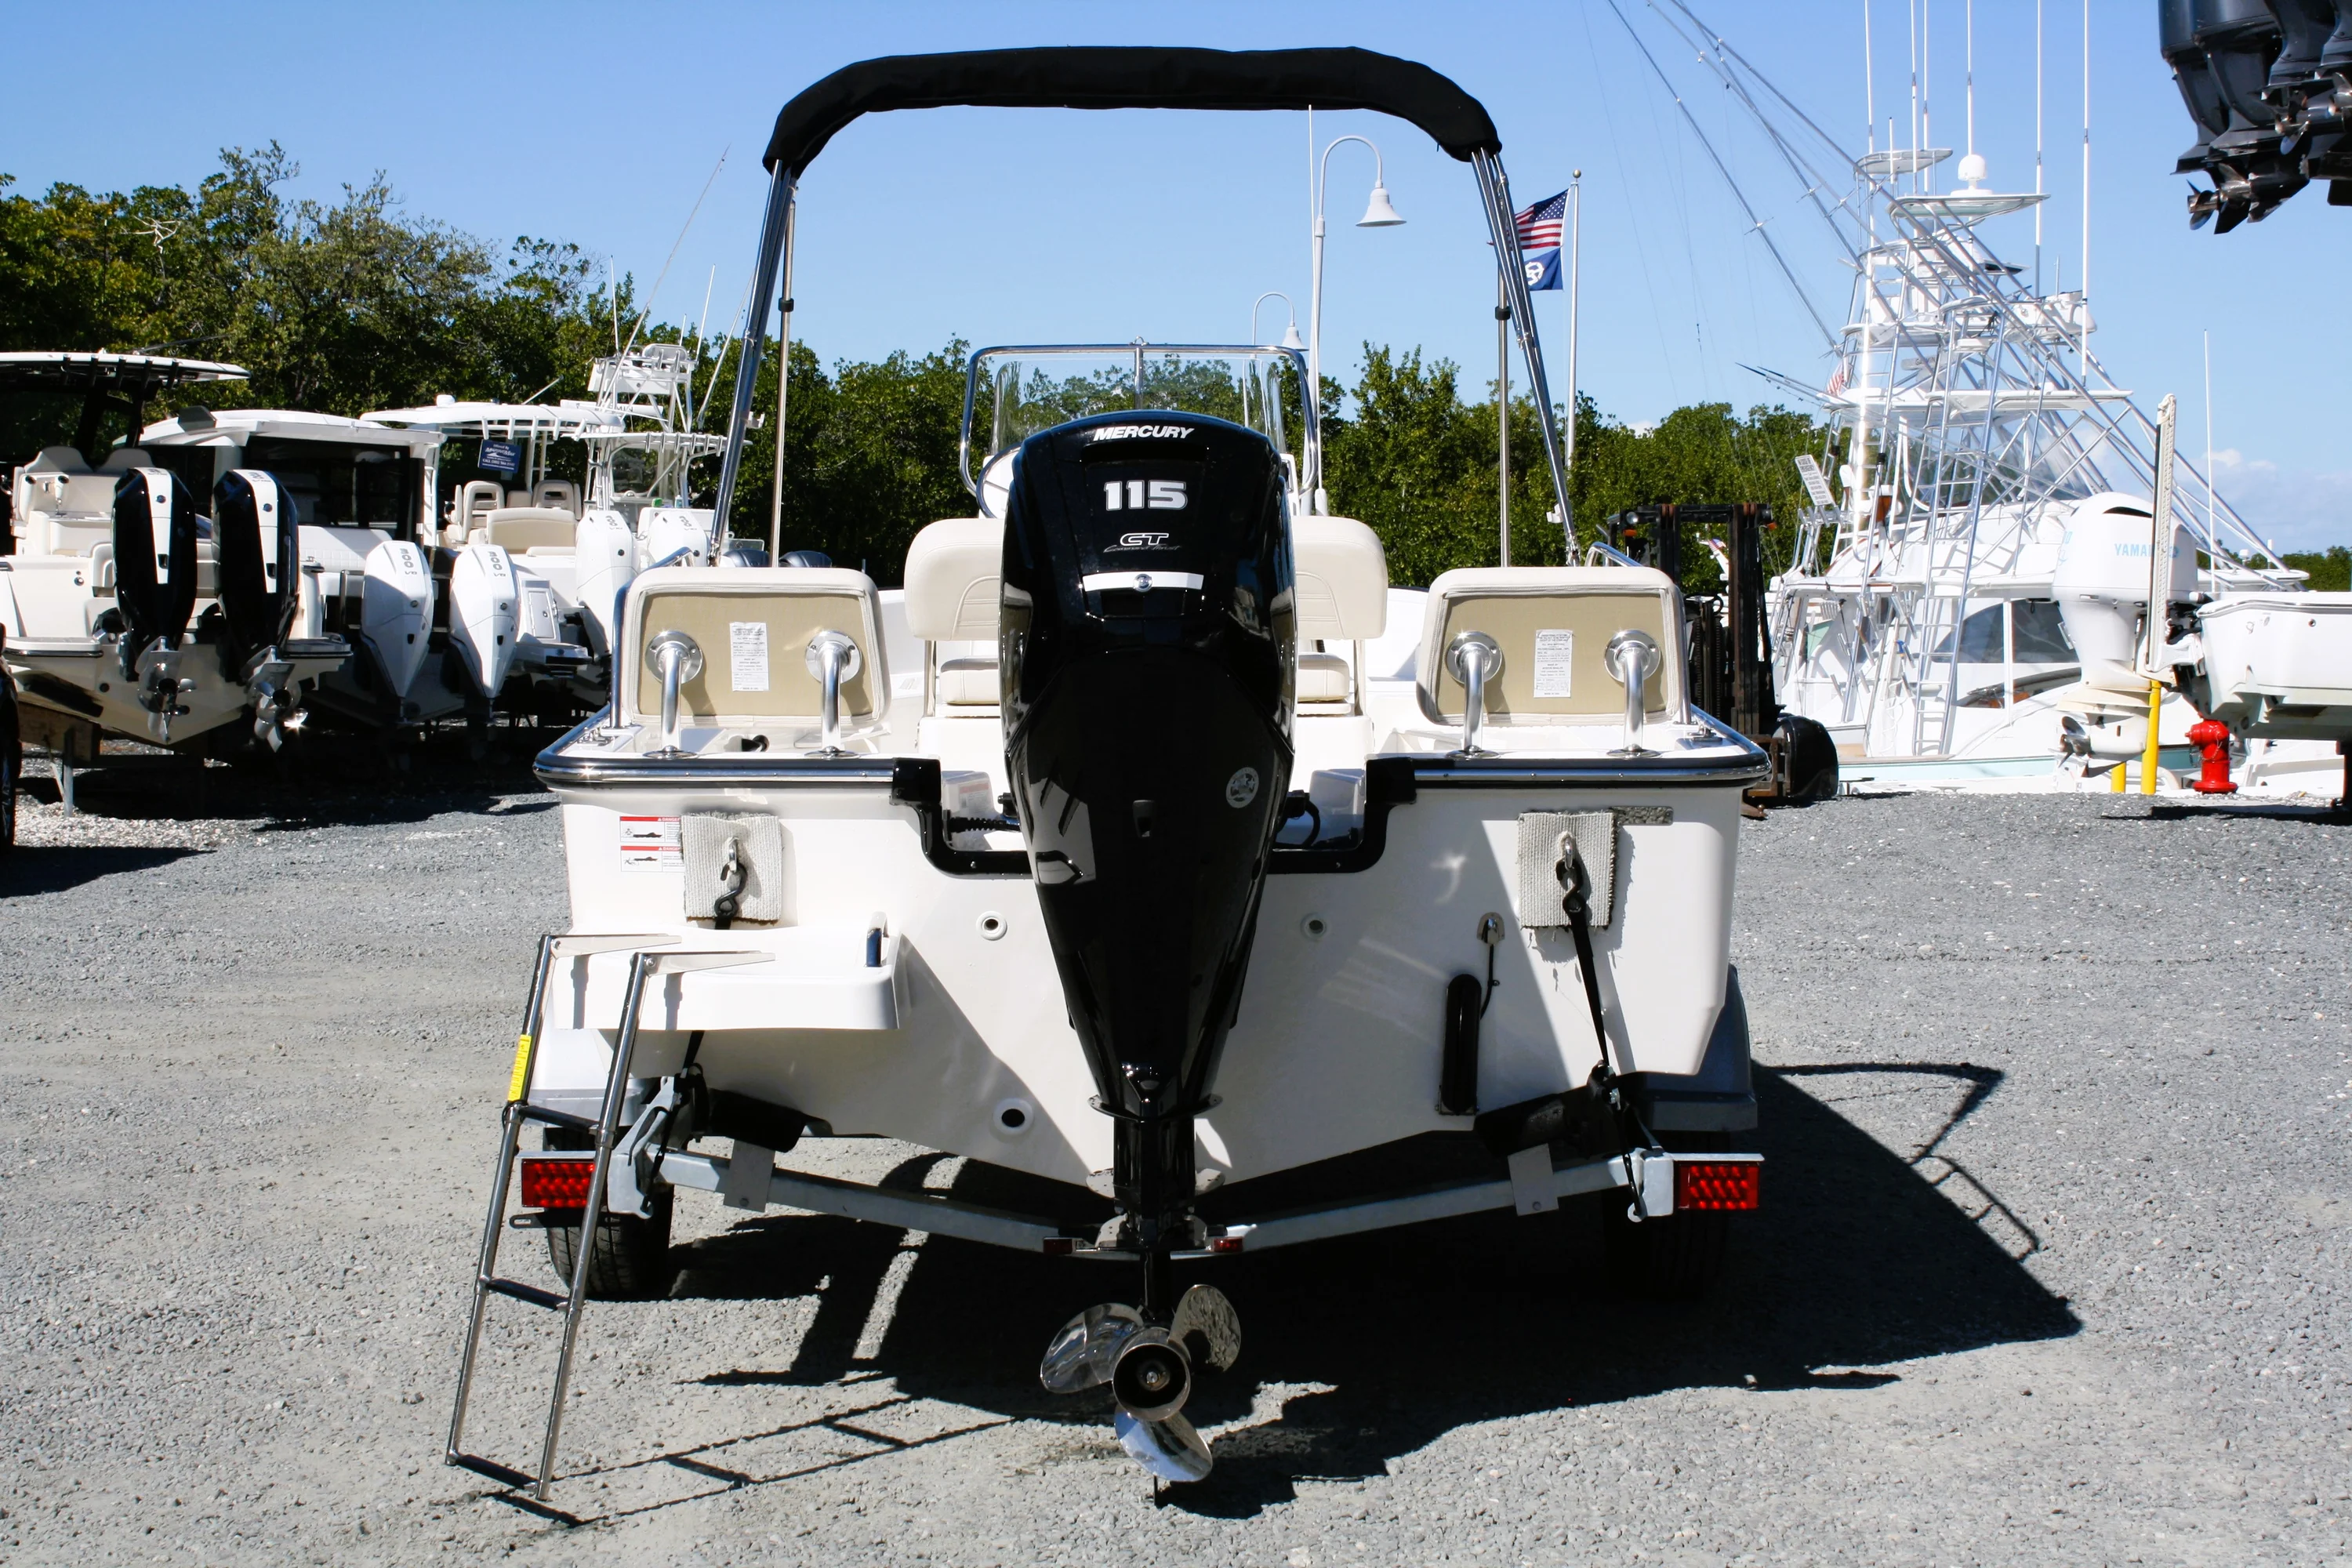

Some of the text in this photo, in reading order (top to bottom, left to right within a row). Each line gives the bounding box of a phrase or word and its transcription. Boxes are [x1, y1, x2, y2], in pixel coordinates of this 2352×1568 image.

[1093, 425, 1195, 441] MERCURY
[1104, 479, 1189, 511] 115
[1120, 532, 1170, 546] GT
[2114, 543, 2154, 557] YAMA
